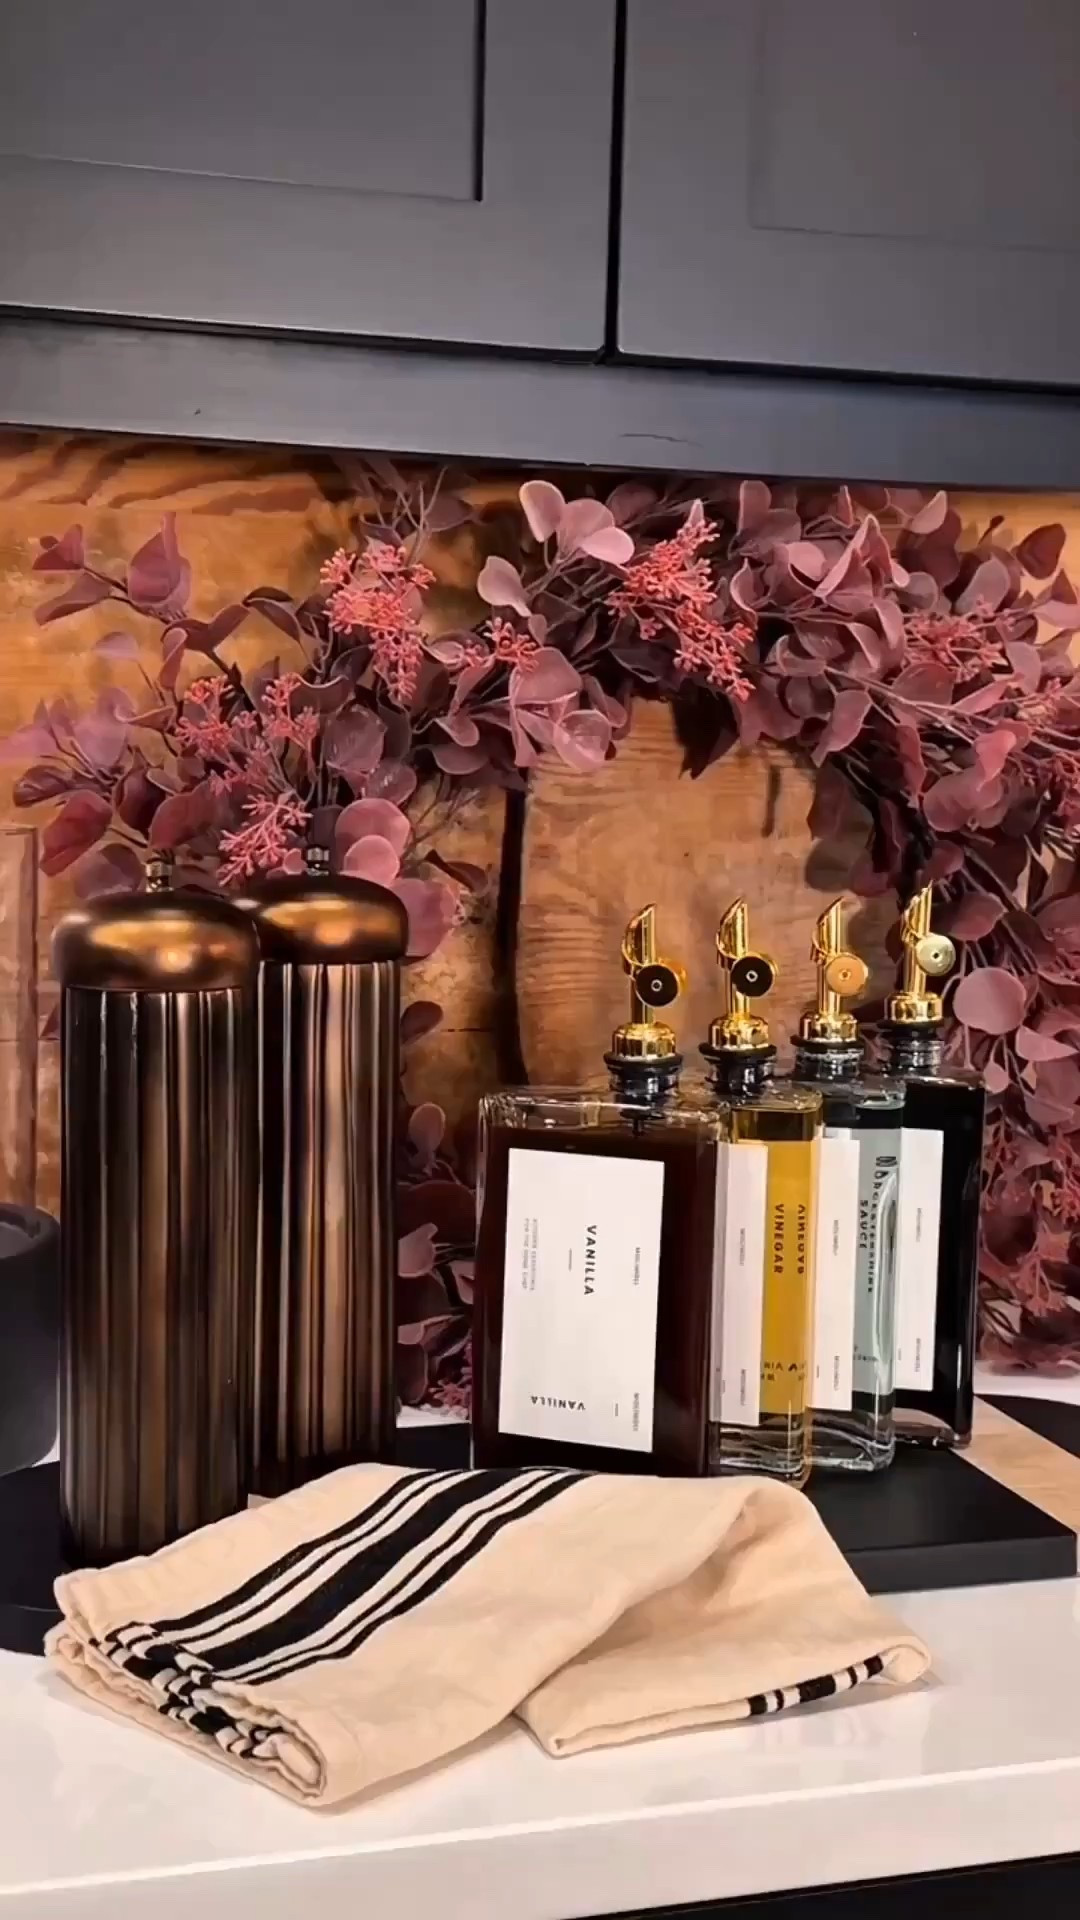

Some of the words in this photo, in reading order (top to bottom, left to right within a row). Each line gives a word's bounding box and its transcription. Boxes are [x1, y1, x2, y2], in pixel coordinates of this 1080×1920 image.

[583, 1224, 598, 1296] VANILLA
[773, 1203, 785, 1275] VINEGAR
[530, 1394, 586, 1412] VANILLA
